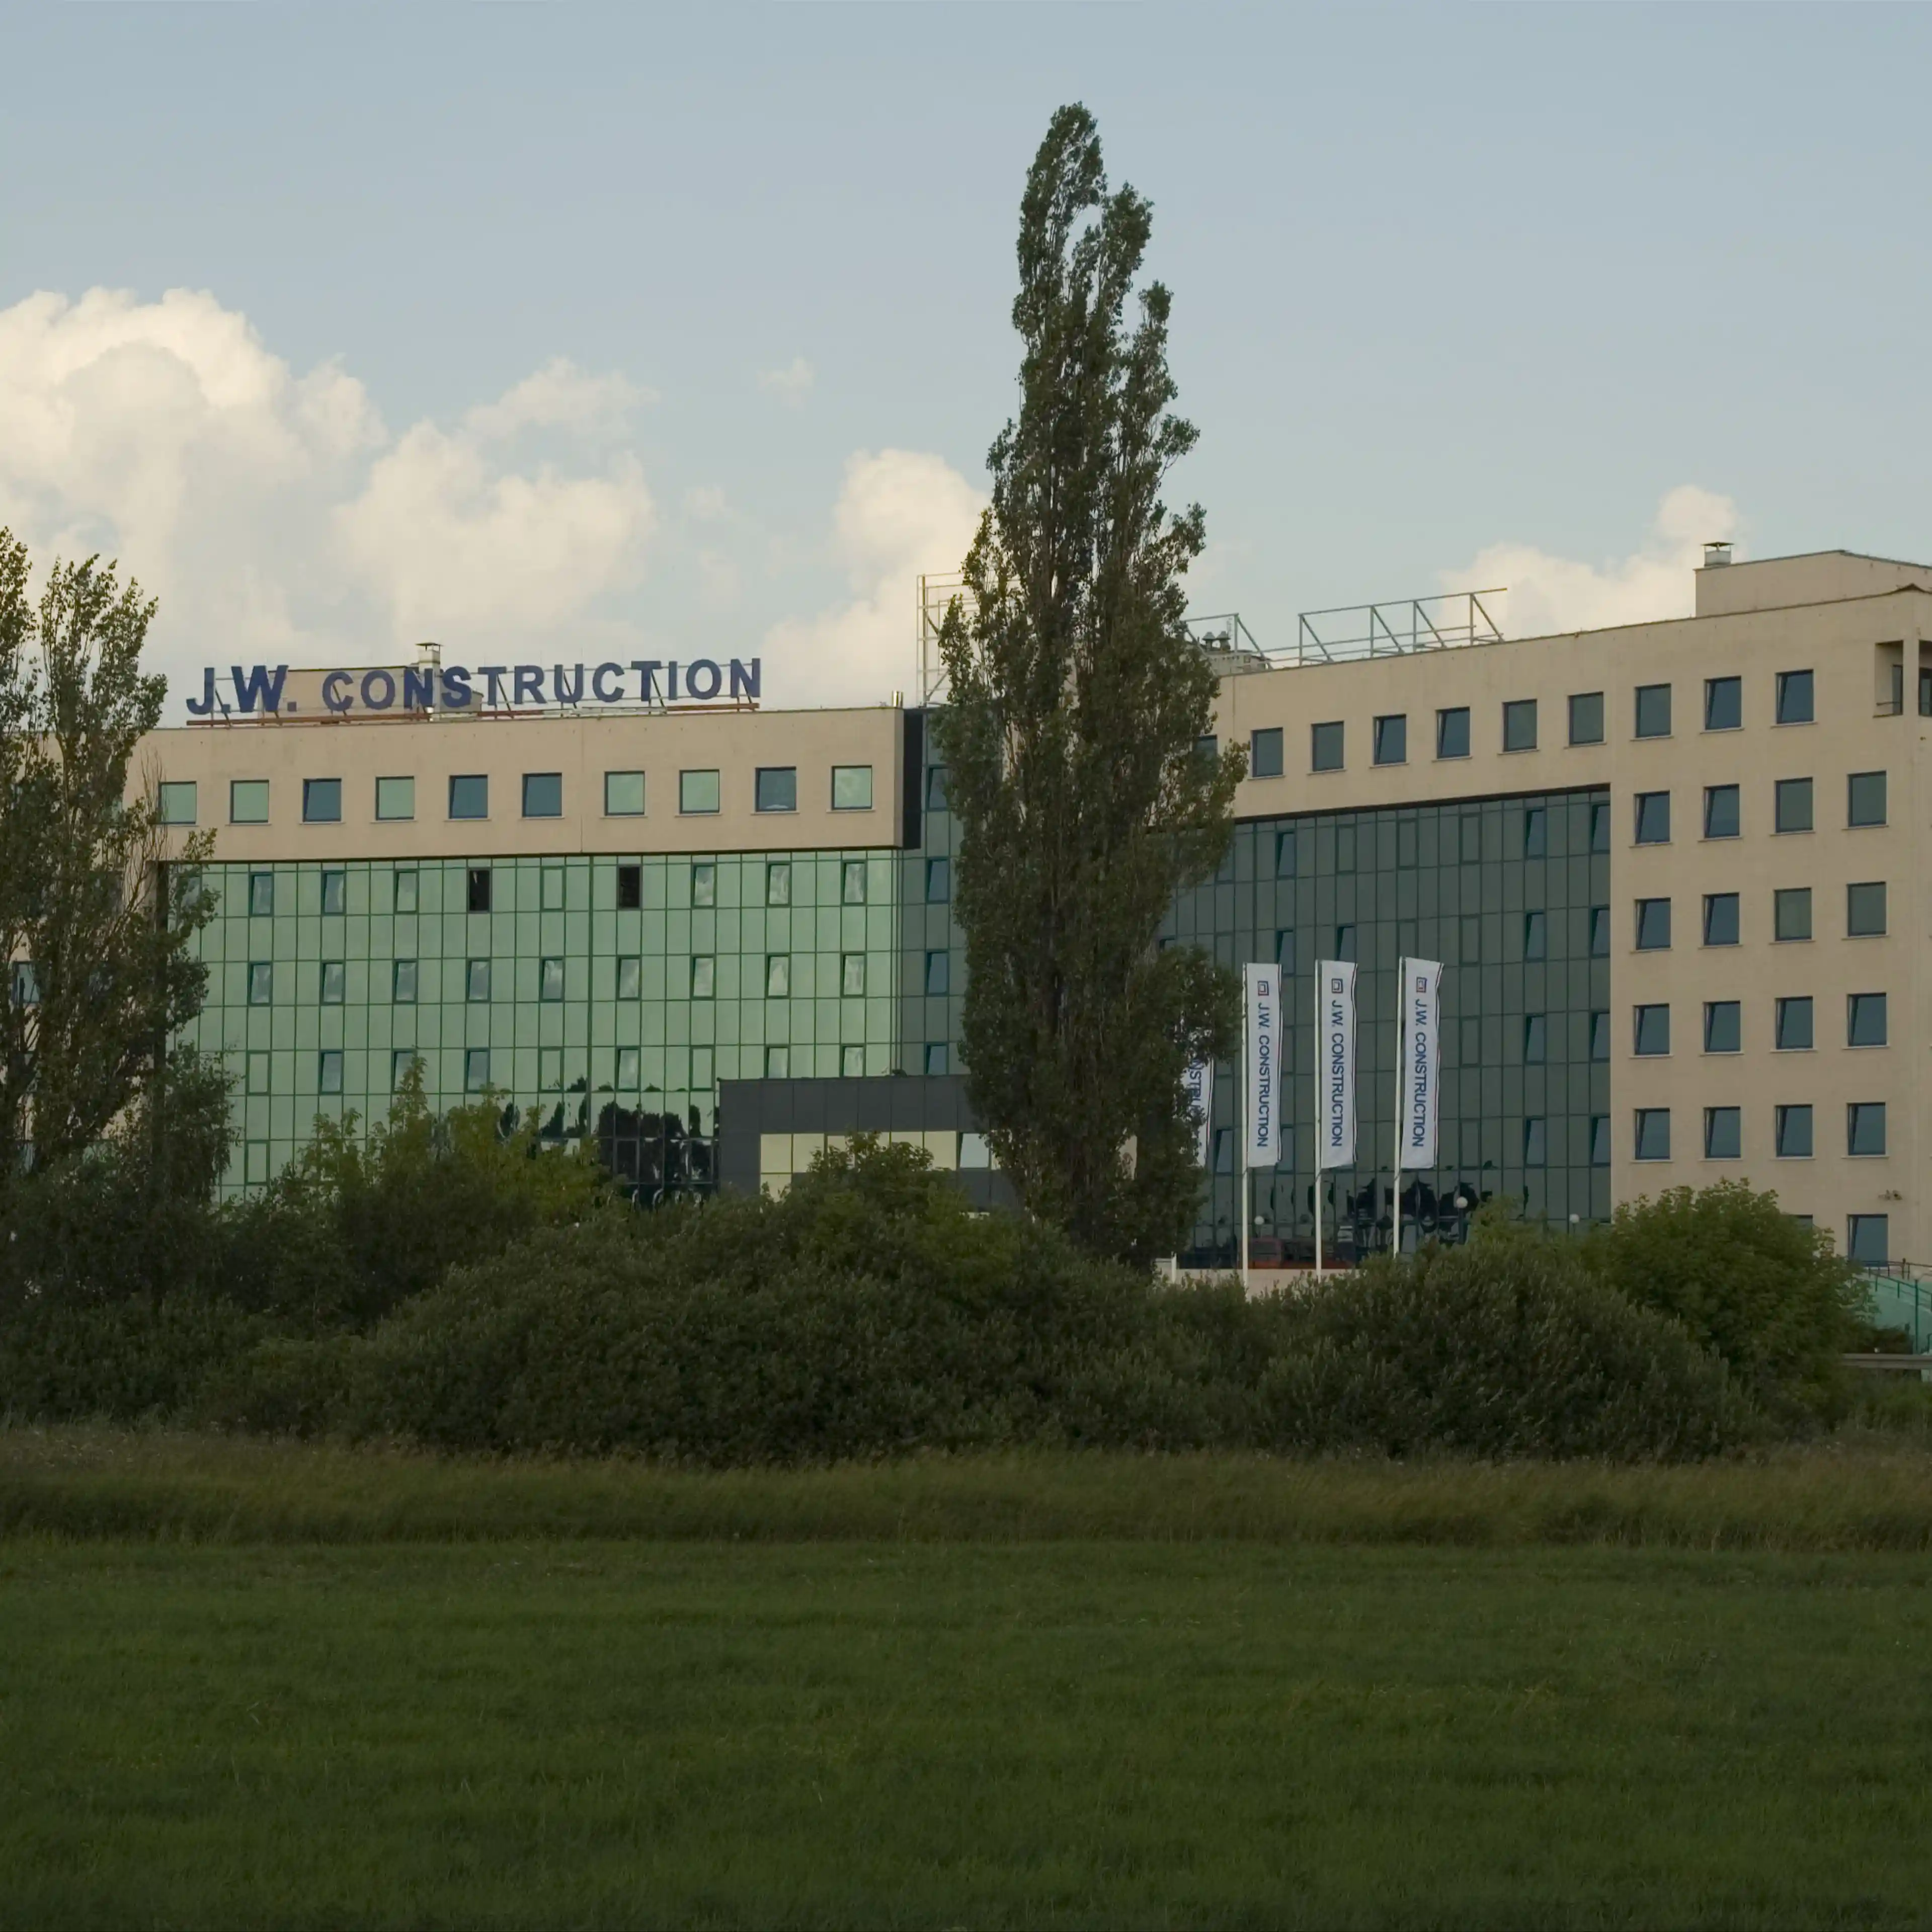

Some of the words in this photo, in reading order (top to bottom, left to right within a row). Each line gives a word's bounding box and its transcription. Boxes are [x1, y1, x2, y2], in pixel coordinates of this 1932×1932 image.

[186, 665, 297, 715] J.W.
[322, 658, 761, 711] CONSTRUCTION
[1258, 1002, 1270, 1029] J.W.
[1331, 1000, 1343, 1027] J.W.
[1415, 999, 1427, 1026] J.W.
[1257, 1035, 1270, 1147] CONSTRUCTION
[1332, 1033, 1344, 1147] CONSTRUCTION
[1412, 1032, 1427, 1147] CONSTRUCTION
